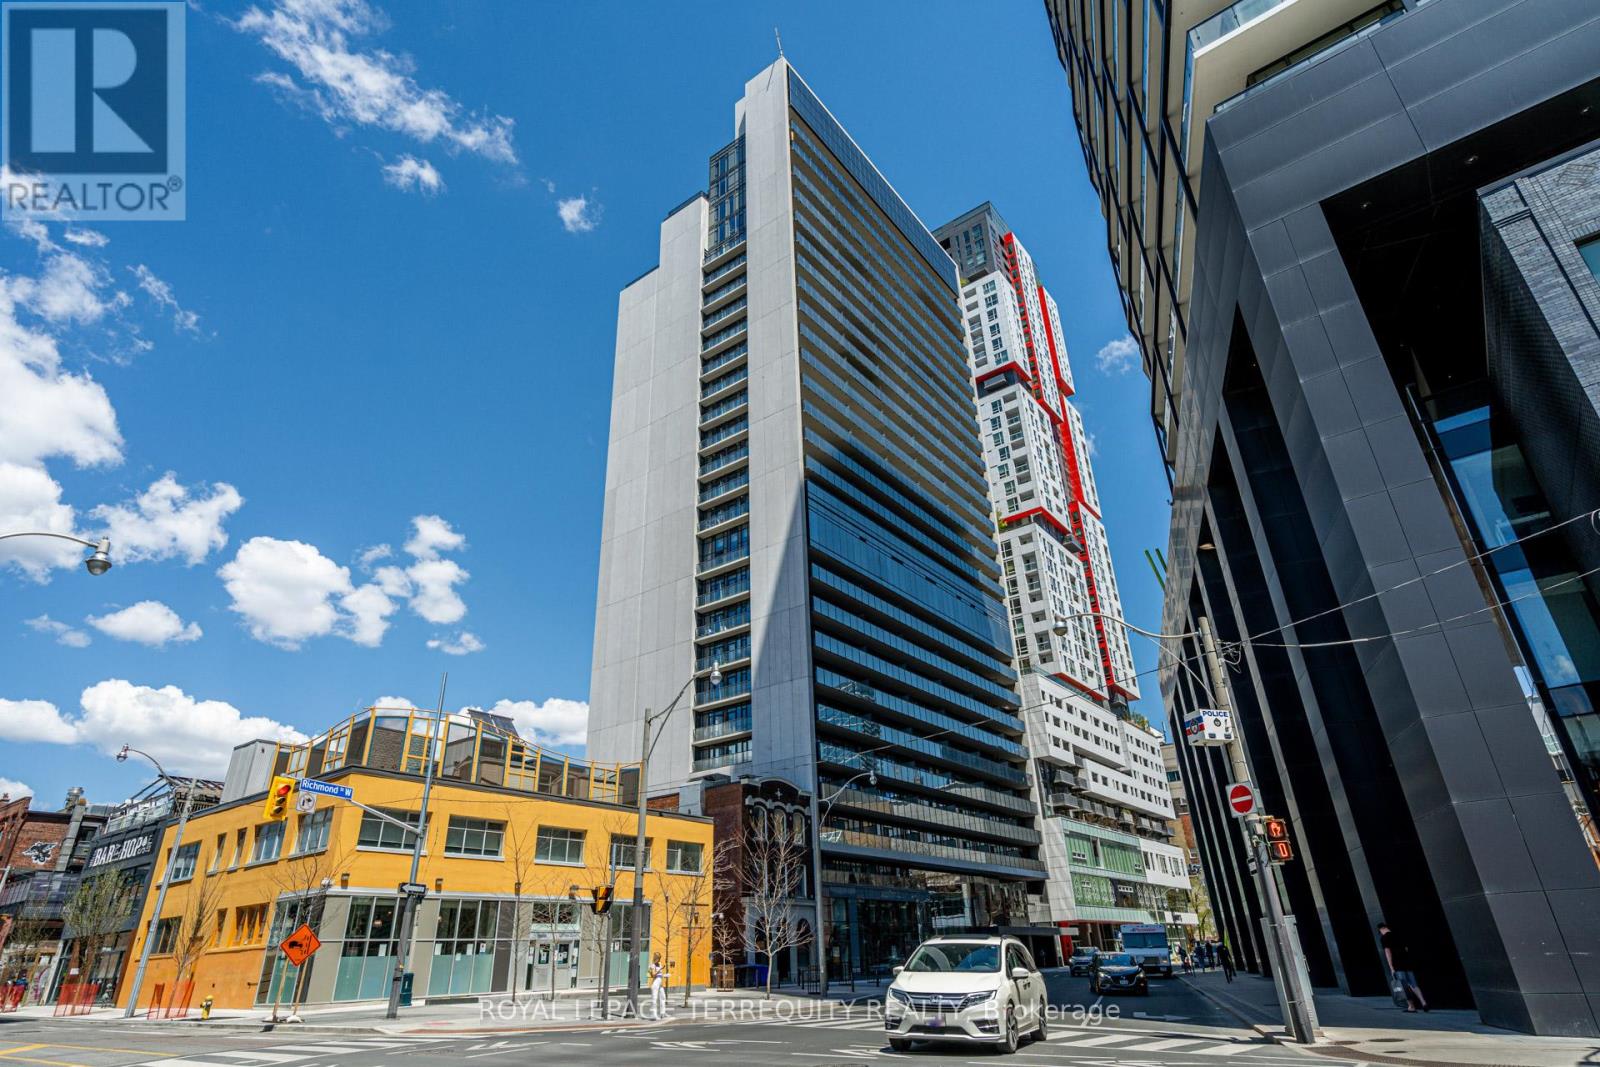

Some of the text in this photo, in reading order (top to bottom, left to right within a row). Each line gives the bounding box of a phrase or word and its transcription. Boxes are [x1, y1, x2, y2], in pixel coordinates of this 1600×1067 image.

[1202, 710, 1229, 718] POLICE
[302, 779, 352, 797] Richmond W
[92, 844, 115, 867] BAR
[120, 836, 144, 860] HOP
